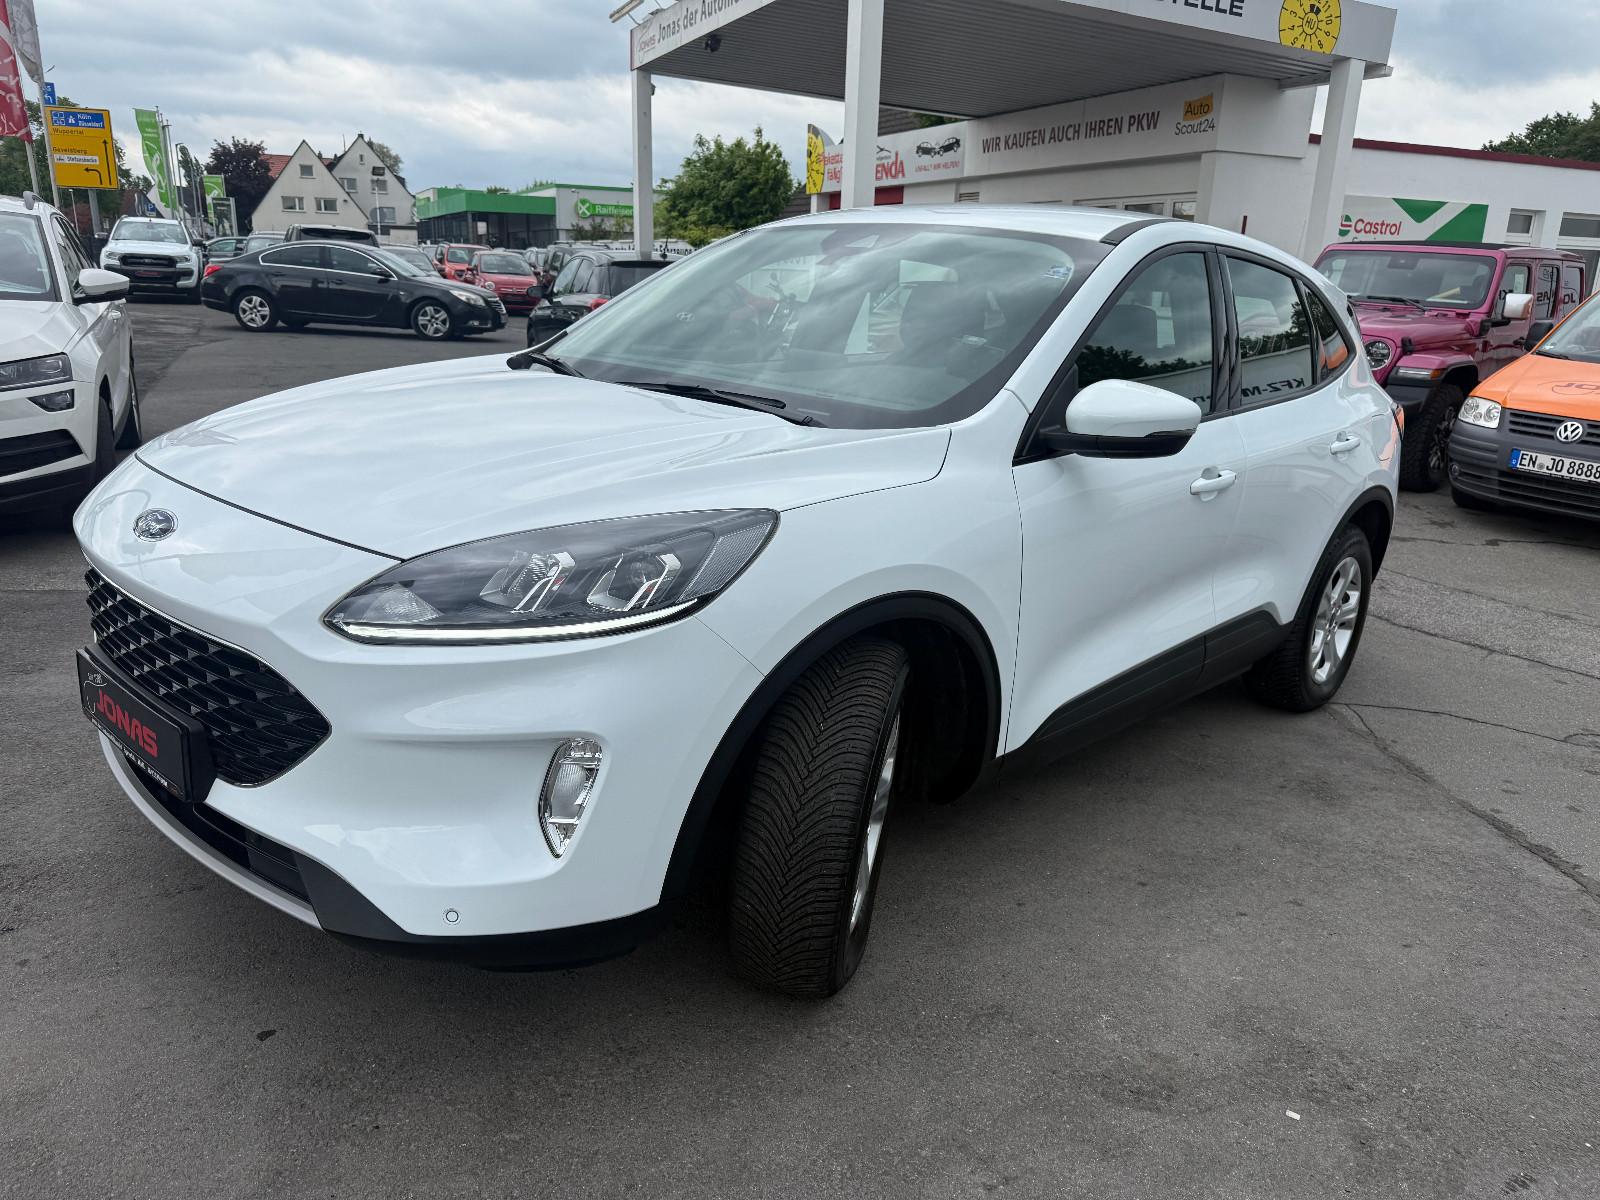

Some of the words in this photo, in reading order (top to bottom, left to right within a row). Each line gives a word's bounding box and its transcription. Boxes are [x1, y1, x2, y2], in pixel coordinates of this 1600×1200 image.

[658, 19, 680, 43] Jonas
[683, 7, 698, 30] der
[700, 0, 741, 22] Autom
[1304, 16, 1317, 30] HU
[1184, 102, 1211, 116] Auto
[981, 137, 1001, 154] WIR
[1004, 127, 1047, 151] KAUFEN
[1048, 122, 1082, 145] AUCH
[1084, 116, 1125, 140] IHREN
[1127, 110, 1161, 134] PKW
[1174, 117, 1216, 136] Scout24
[1353, 217, 1402, 236] Castrol
[1518, 452, 1538, 469] EN
[1546, 457, 1565, 474] JO
[1566, 461, 1600, 480] 8888
[96, 688, 158, 758] JONAS
